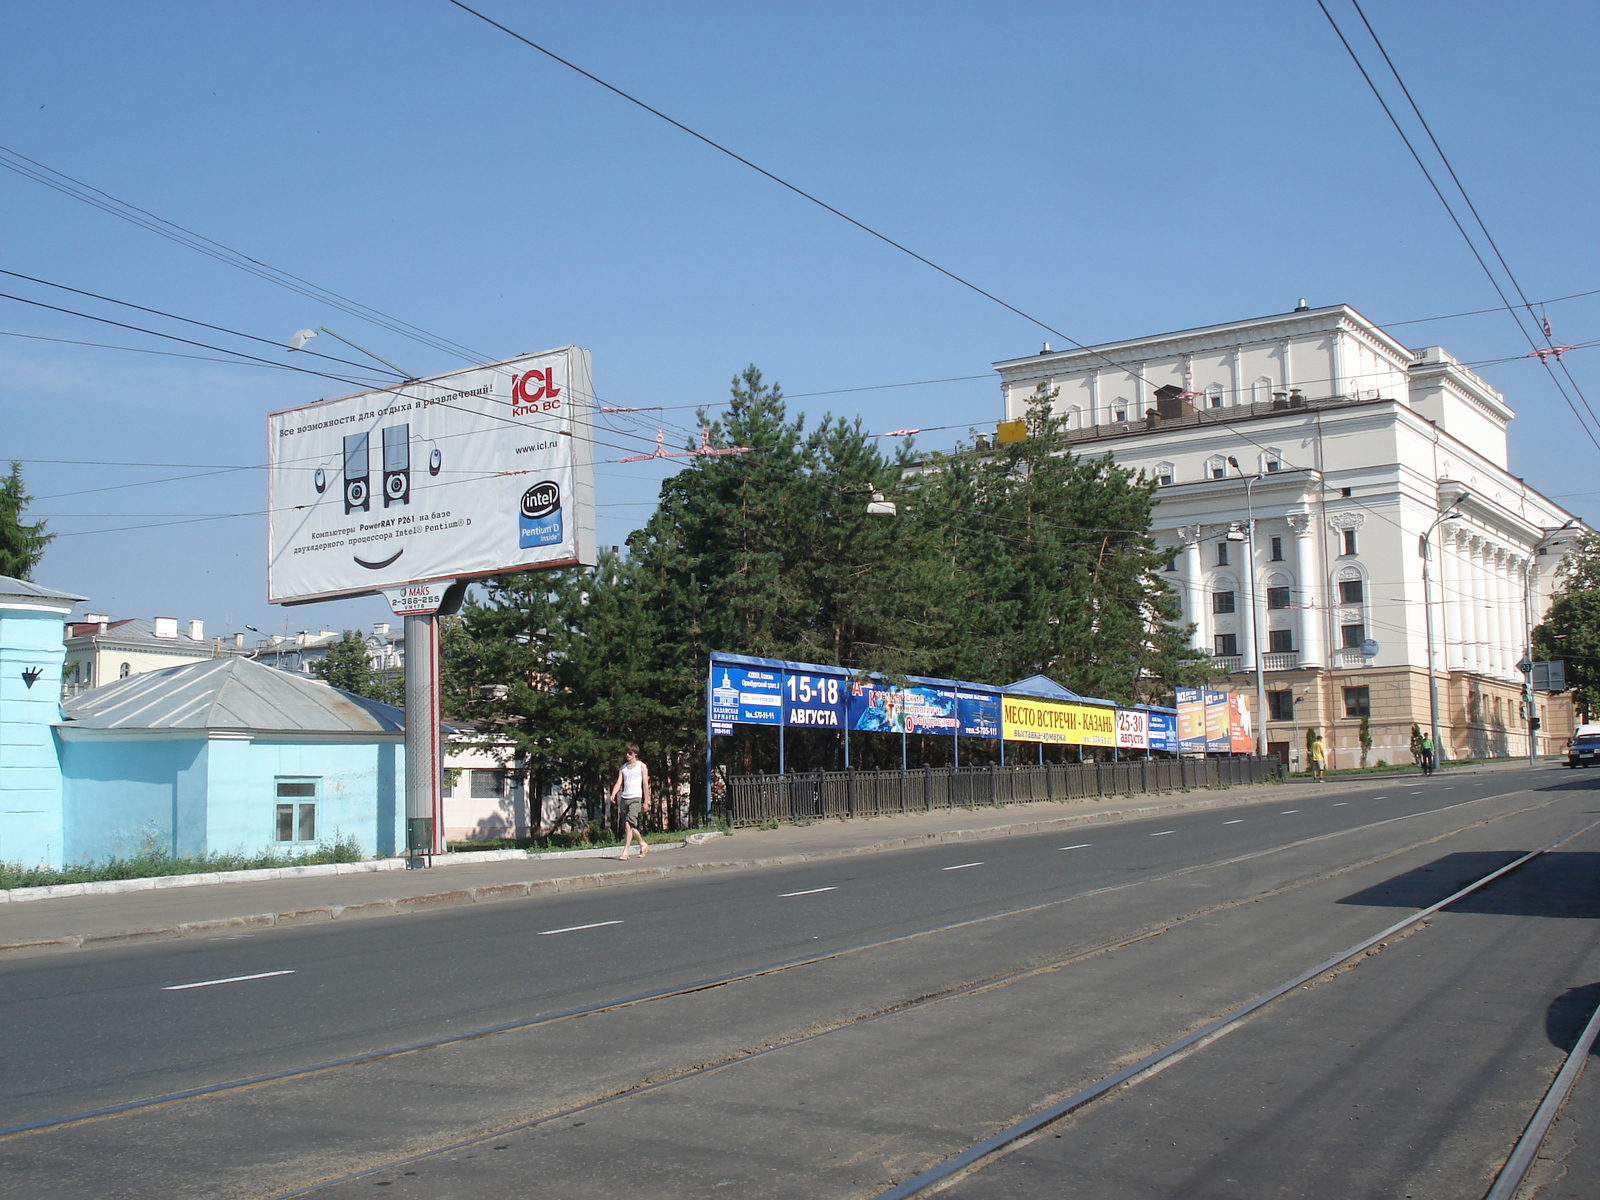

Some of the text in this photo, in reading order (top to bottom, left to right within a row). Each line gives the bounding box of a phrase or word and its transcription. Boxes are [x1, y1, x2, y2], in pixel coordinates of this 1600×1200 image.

[279, 383, 493, 438] Все возможности для отдыха и развлечений!
[512, 400, 561, 417] КПО ВС
[515, 440, 558, 454] www.icl.ru
[526, 489, 553, 508] intel
[311, 510, 451, 540] Компьютеры PowerRAY P261 на базе
[553, 523, 559, 533] D
[293, 540, 344, 555] двухядерного
[348, 533, 393, 546] процессора
[466, 518, 472, 526] D
[392, 596, 440, 606] 2-366-255
[786, 674, 839, 705] 15-18
[790, 708, 838, 726] АВГУСТА
[1004, 705, 1035, 726] МЕСТО
[1037, 709, 1077, 730] ВСТРЕЧИ
[1082, 713, 1113, 733] КАЗАНЬ
[1120, 713, 1143, 733] 25-30
[1013, 729, 1066, 743] выставка-ярмарка
[1120, 732, 1144, 746] августа
